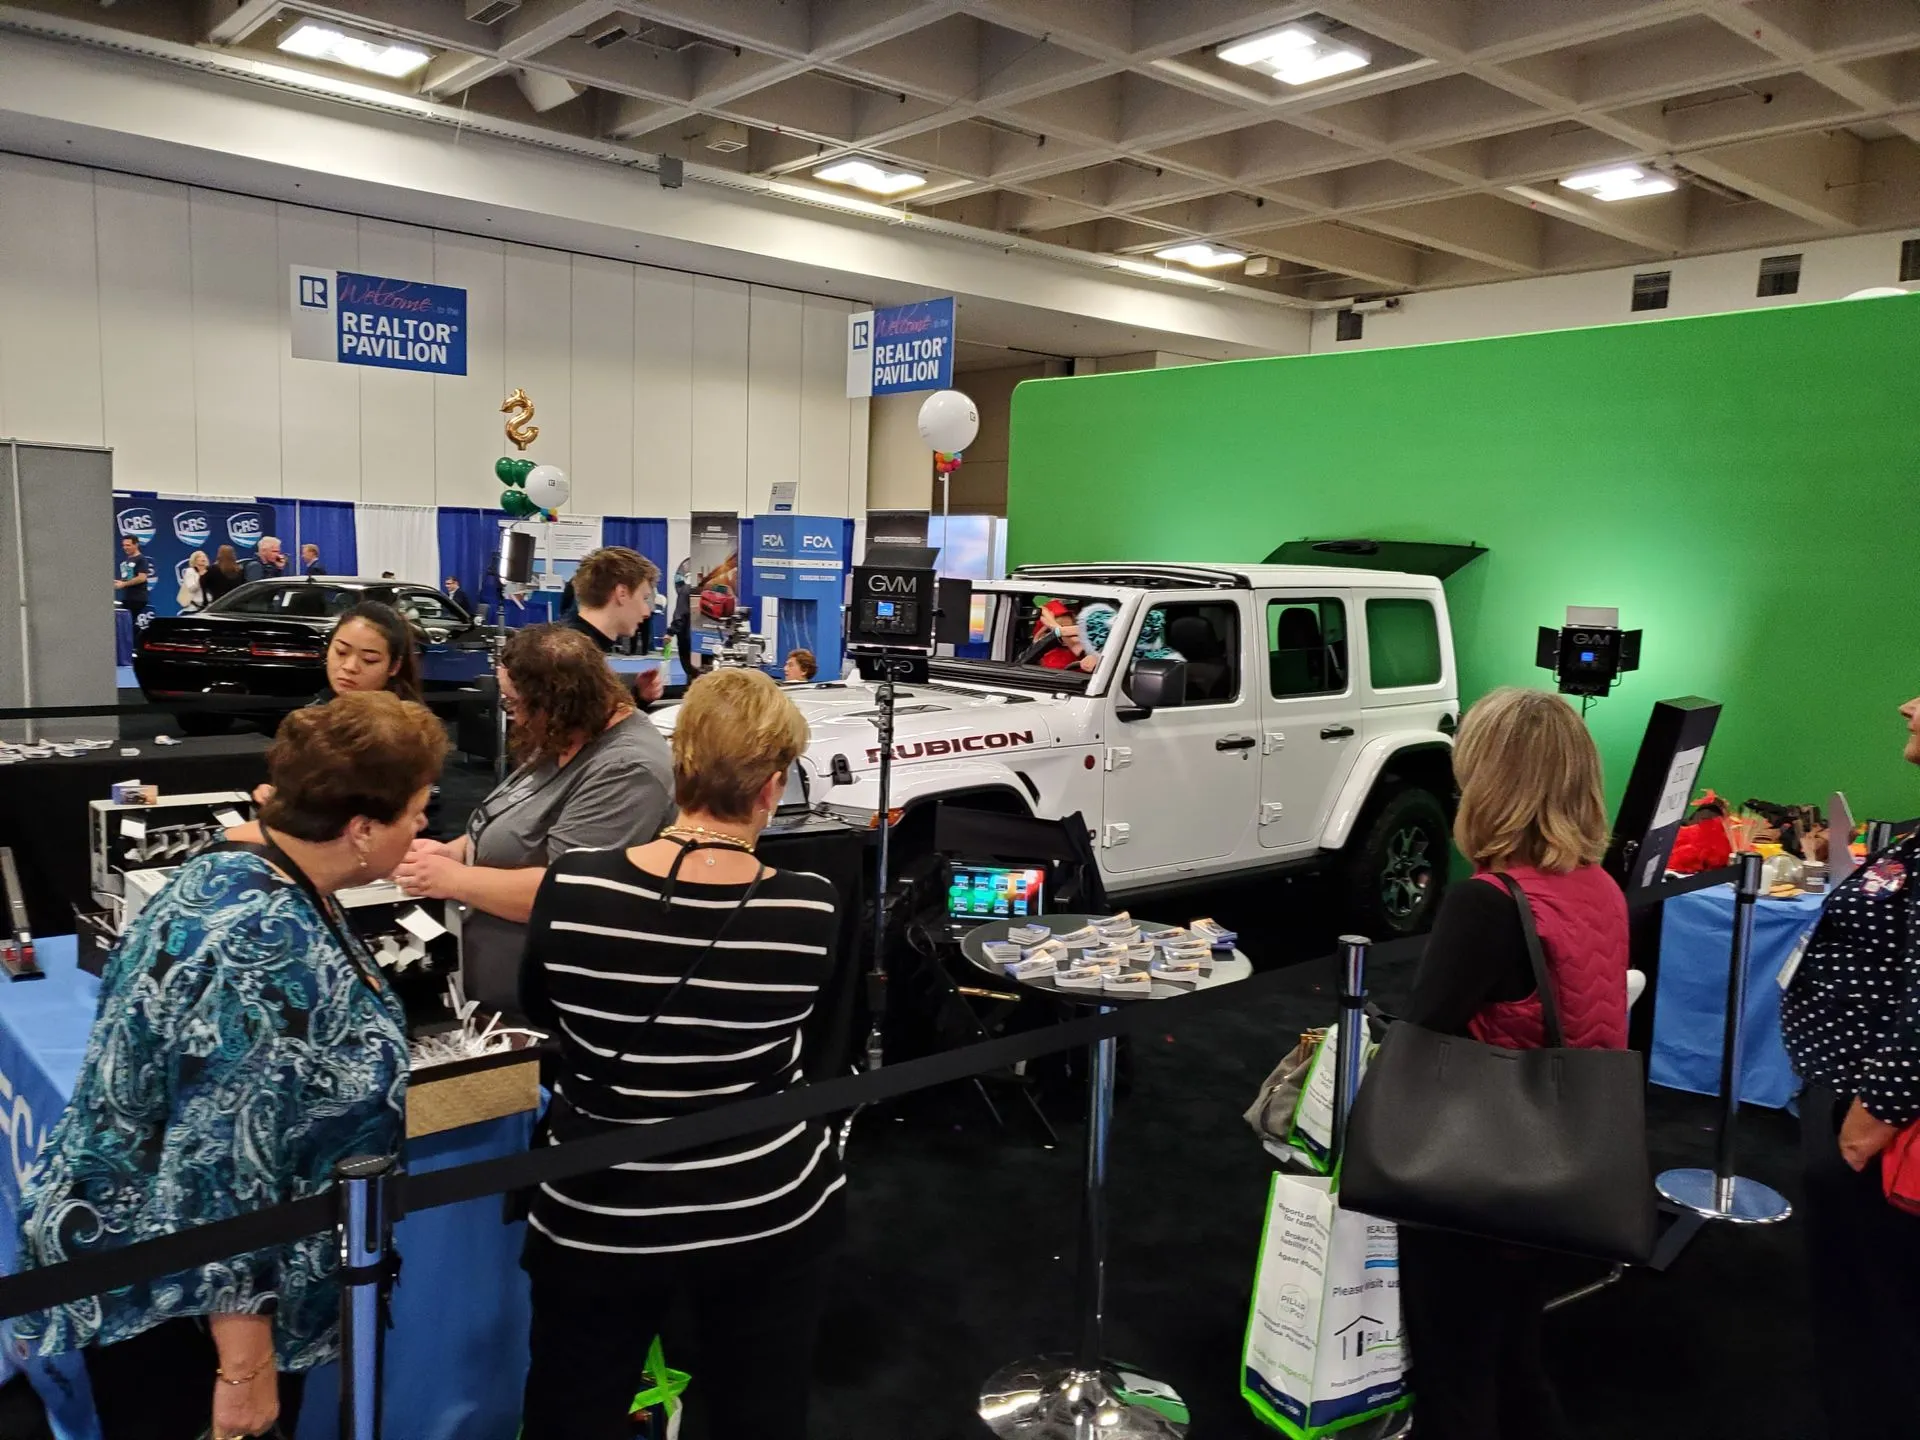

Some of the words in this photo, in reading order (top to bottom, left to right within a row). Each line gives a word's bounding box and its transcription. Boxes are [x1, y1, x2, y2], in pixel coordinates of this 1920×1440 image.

[338, 274, 433, 312] Welcome
[342, 333, 448, 365] PAVILION
[873, 359, 940, 387] PAVILION
[123, 514, 153, 531] CRS
[179, 517, 208, 532] CRS
[232, 518, 260, 534] CRS
[762, 534, 785, 547] FCA
[802, 535, 834, 549] FCA
[867, 574, 917, 593] GVM
[865, 730, 1034, 764] RUBICON
